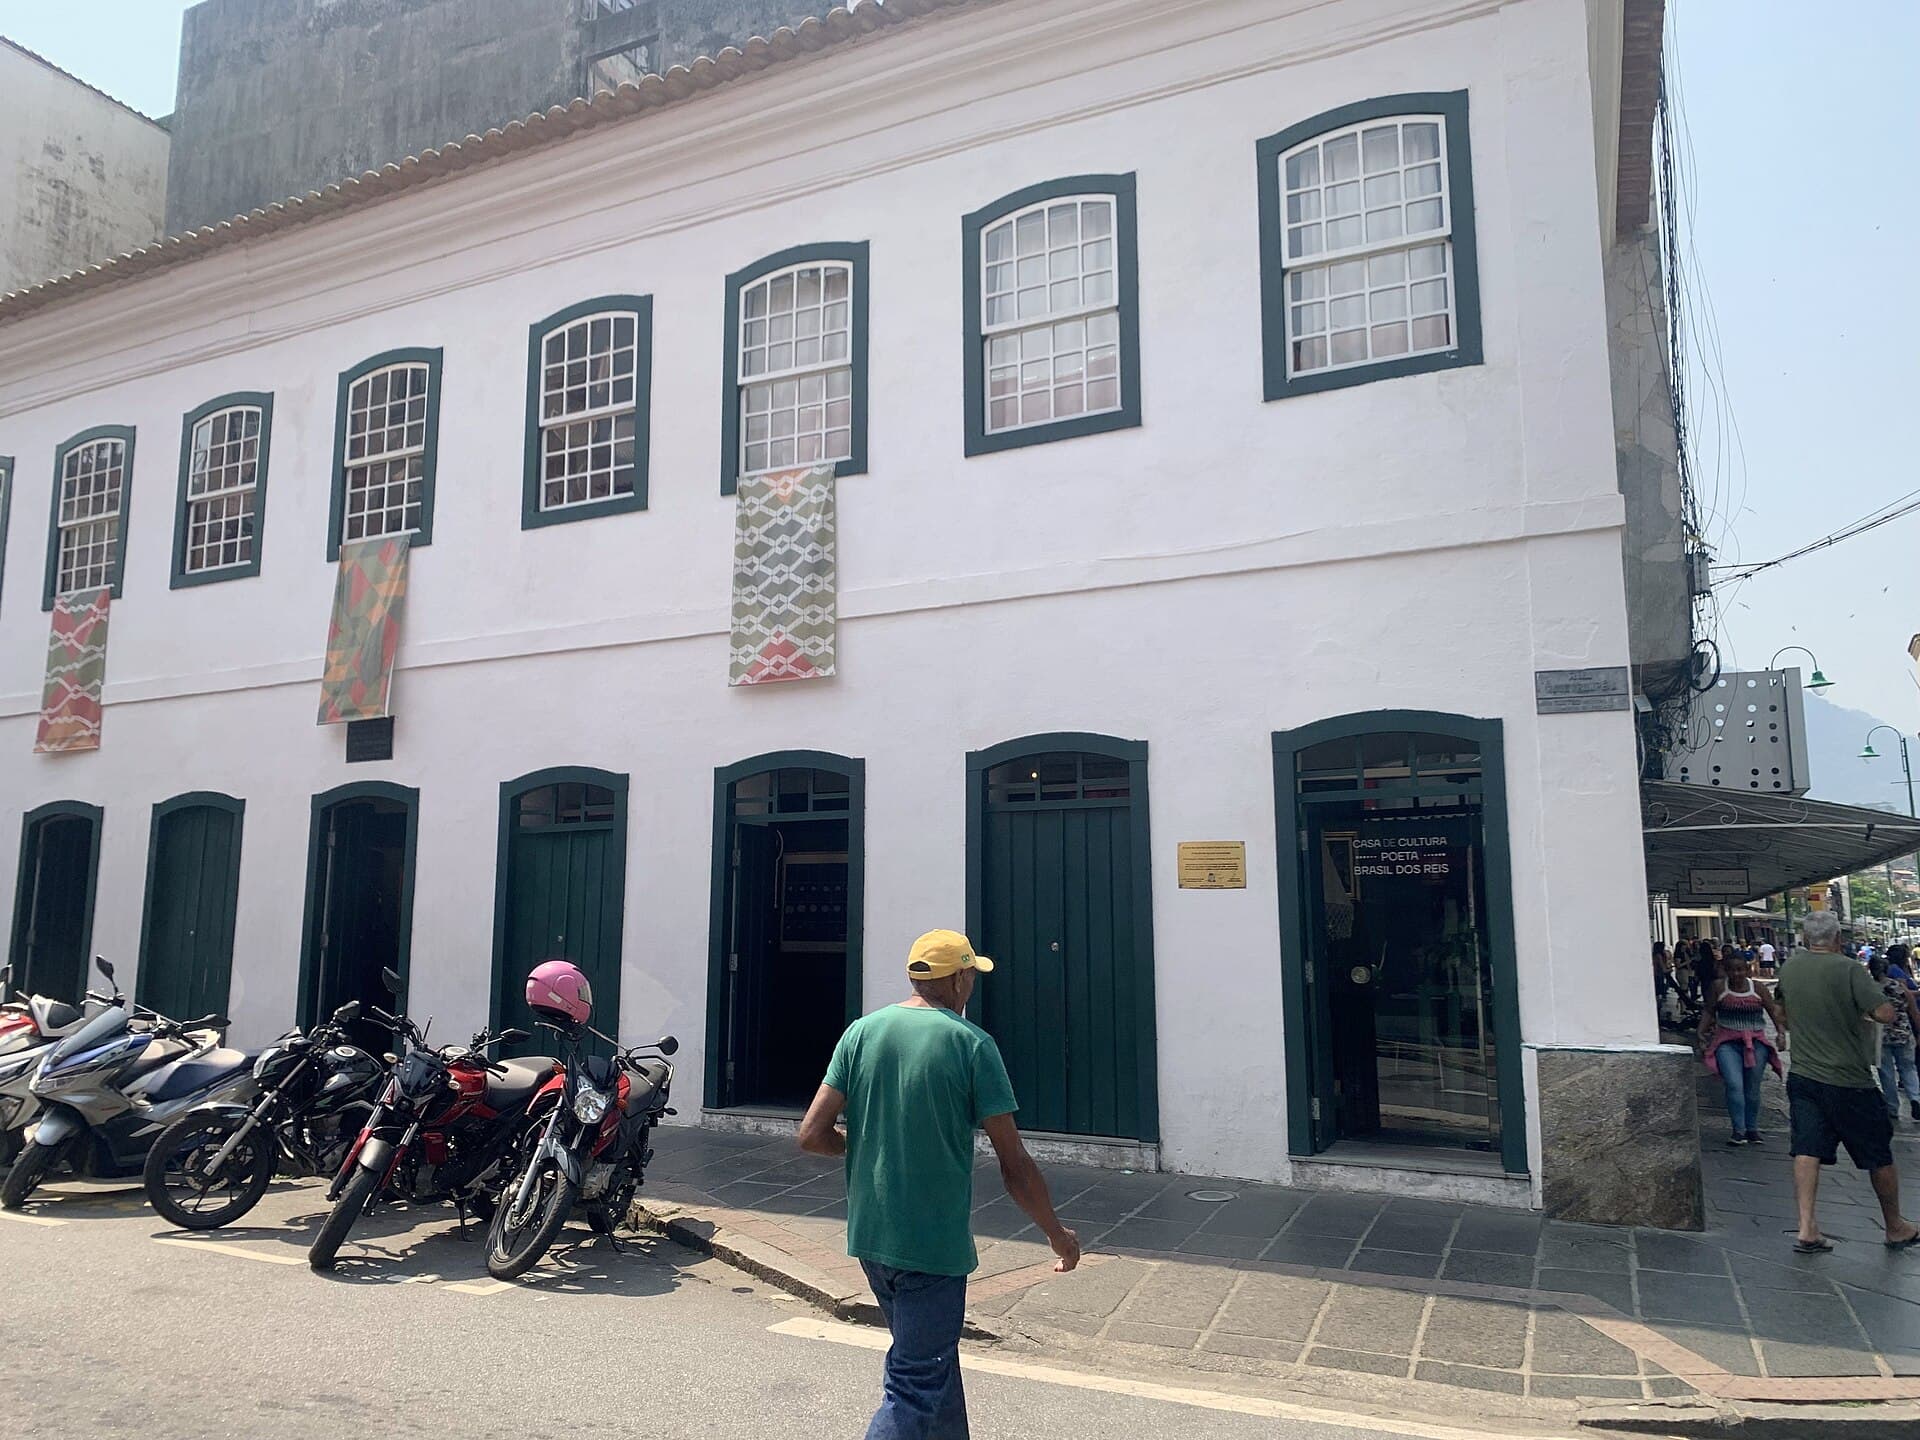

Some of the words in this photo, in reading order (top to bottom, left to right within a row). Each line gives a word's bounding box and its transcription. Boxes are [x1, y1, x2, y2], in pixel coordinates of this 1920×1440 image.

[1352, 839, 1380, 849] CASA
[1382, 839, 1397, 848] DE
[1397, 837, 1448, 847] CULTURA
[1380, 851, 1419, 862] POETA
[1353, 865, 1393, 876] BRASIL
[1395, 864, 1421, 875] DOS
[1423, 863, 1449, 874] REIS
